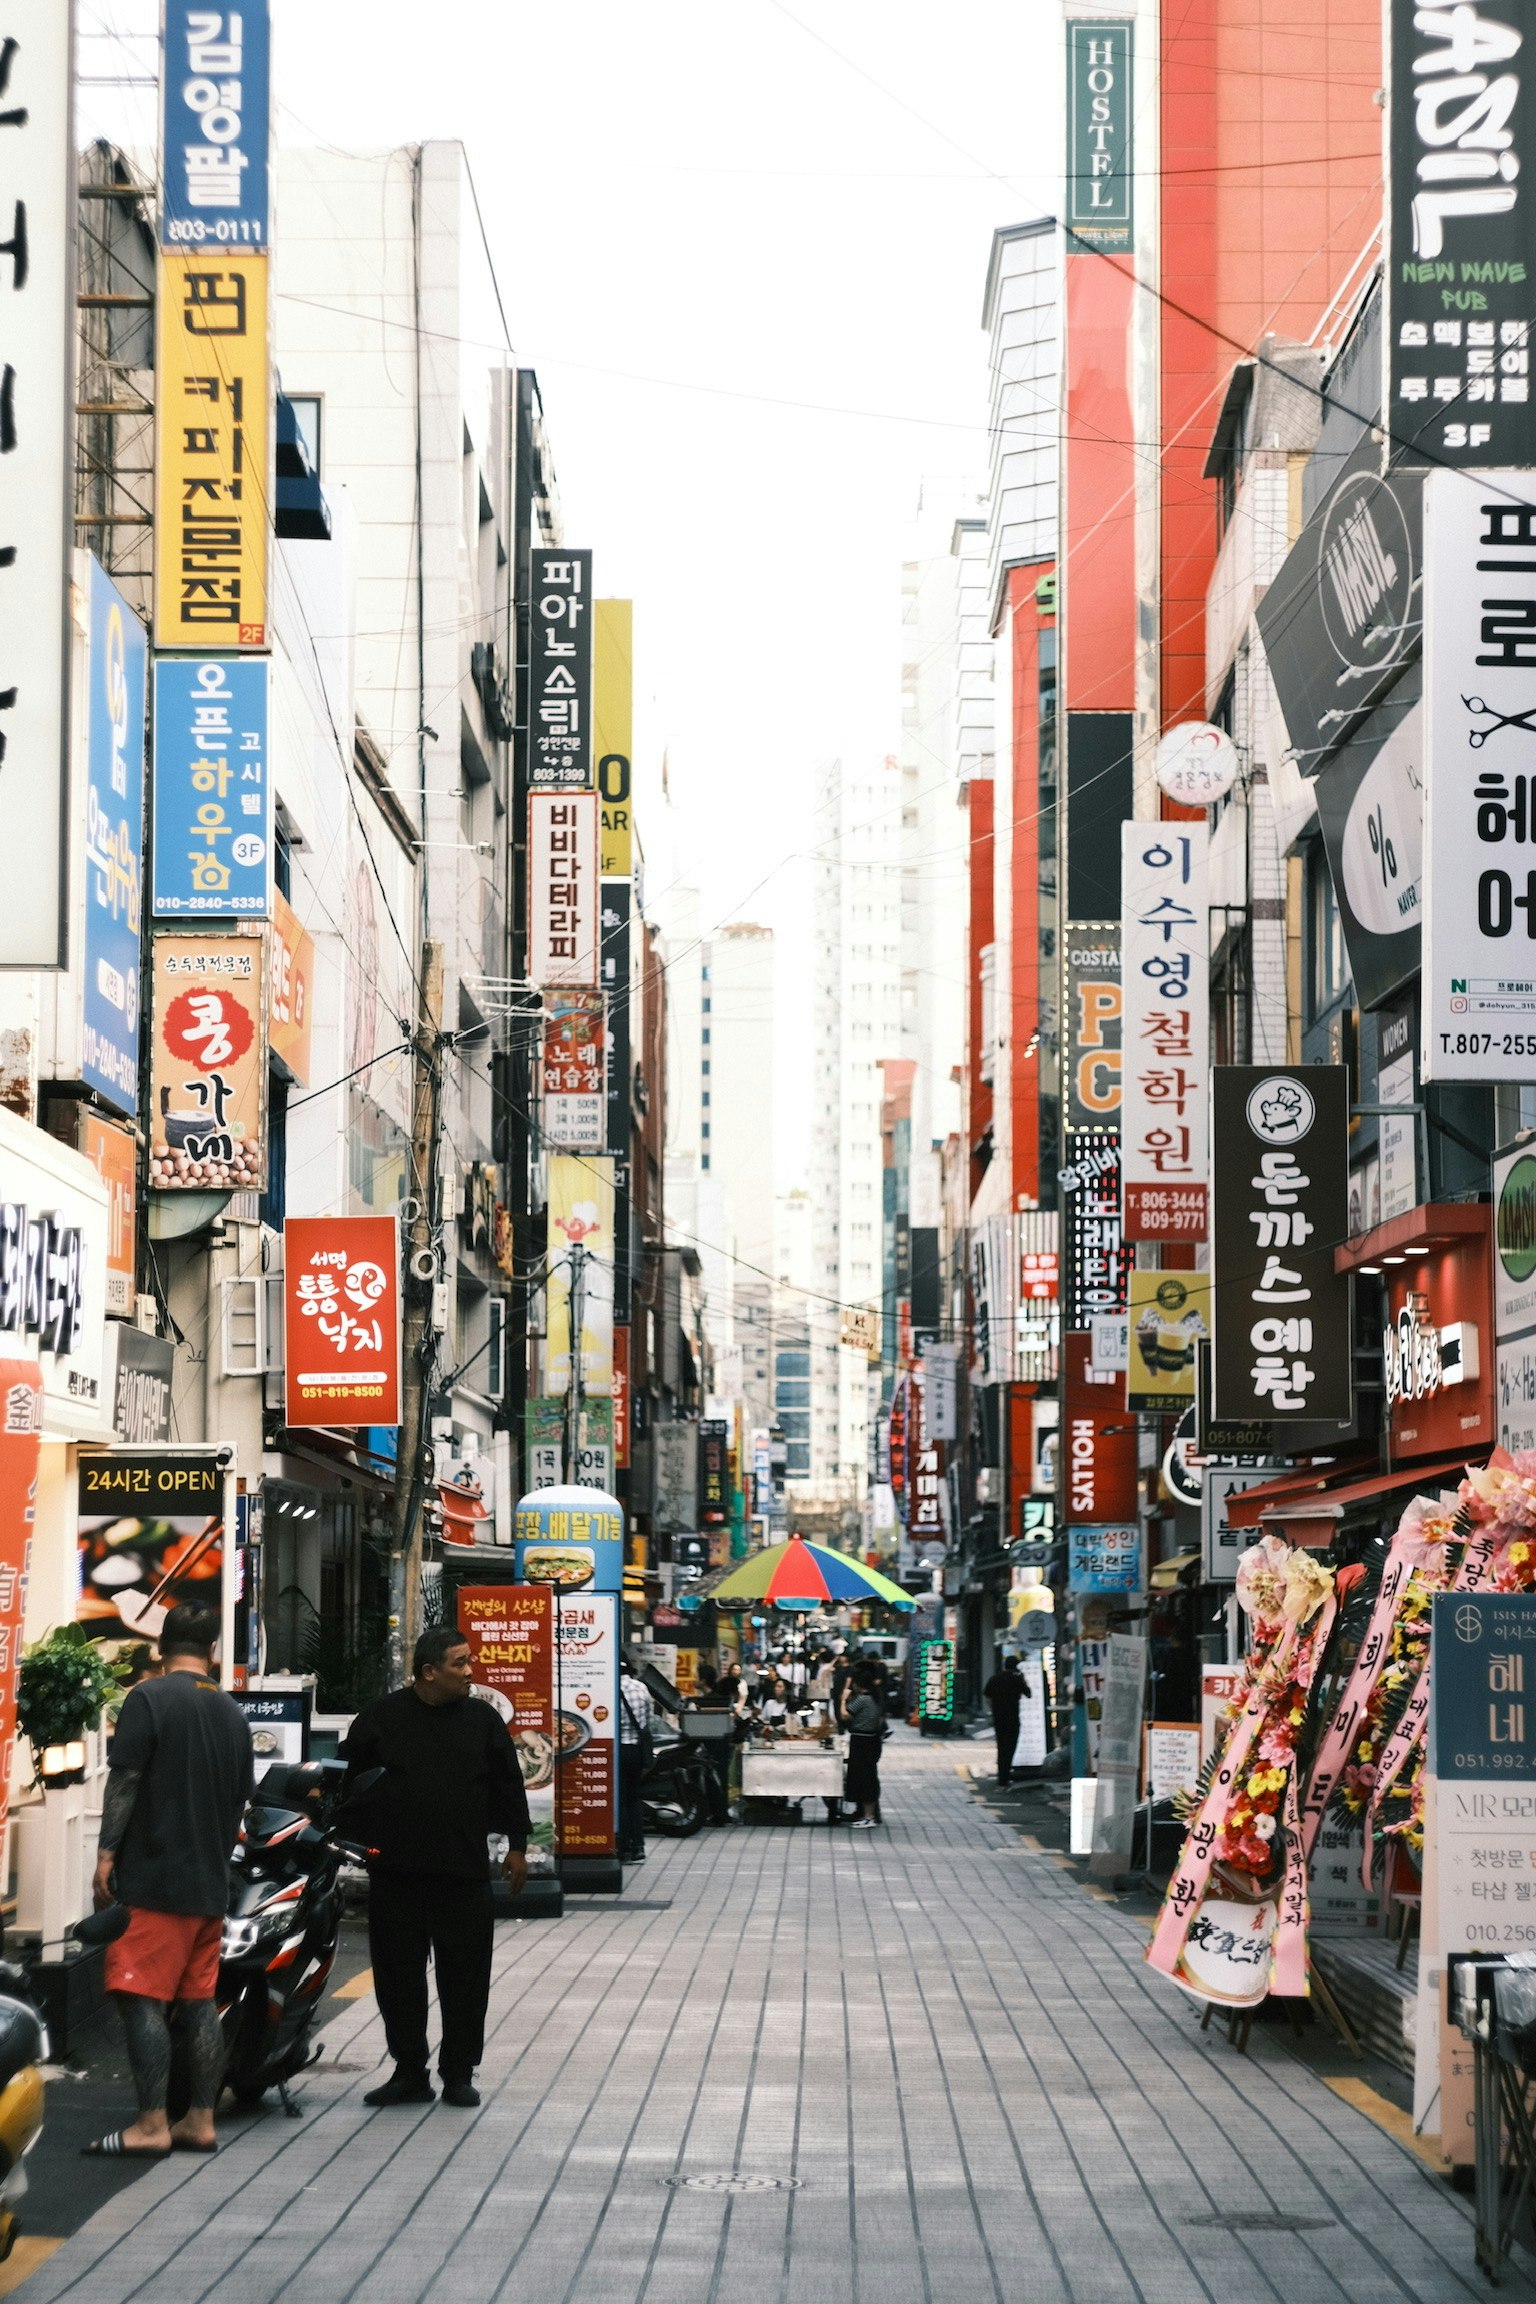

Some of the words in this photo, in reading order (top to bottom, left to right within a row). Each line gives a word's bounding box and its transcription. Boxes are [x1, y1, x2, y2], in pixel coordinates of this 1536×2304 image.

[183, 12, 248, 207] 김영팔
[1087, 39, 1114, 207] HOSTEL
[1412, 0, 1522, 258] ASiL
[168, 220, 262, 241] 803-0111
[1402, 261, 1454, 283] NEW
[1461, 261, 1526, 283] WAVE
[1441, 289, 1488, 311] PUB
[1443, 423, 1492, 447] 3F
[180, 376, 243, 624] 커피전문점
[241, 626, 263, 643] 2F
[240, 732, 262, 815] 고시텔
[237, 843, 260, 858] 3F
[550, 804, 581, 959] 비비다테라피
[156, 896, 265, 910] 010-2840-5336
[165, 954, 252, 973] 순두부전문점
[1070, 950, 1120, 966] COSTA
[1382, 1015, 1409, 1057] WOMEN
[551, 1043, 597, 1067] 노래
[181, 994, 234, 1162] 콩가네
[544, 1066, 603, 1091] 연습장
[1141, 1210, 1205, 1229] 809-9771
[1249, 1152, 1314, 1304] 돈까스
[310, 1250, 347, 1270] 서면
[318, 1311, 382, 1353] 낙지
[1250, 1317, 1315, 1410] 예찬
[302, 1385, 383, 1399] 051-819-8500
[537, 1450, 555, 1468] 1곡
[1071, 1419, 1095, 1512] HOLLYS
[87, 1469, 151, 1492] 24시간
[158, 1470, 216, 1491] OPEN
[1074, 1553, 1136, 1572] 게임랜드
[513, 1598, 546, 1615] 산삼
[1493, 1610, 1517, 1620] ISIS
[470, 1620, 508, 1632] 바다에서
[502, 1632, 529, 1642] 신선한
[479, 1644, 532, 1664] 산낙지
[1471, 1849, 1524, 1869] 첫방문
[1472, 1881, 1507, 1901] 타샵
[1466, 1924, 1536, 1942] 010.256
